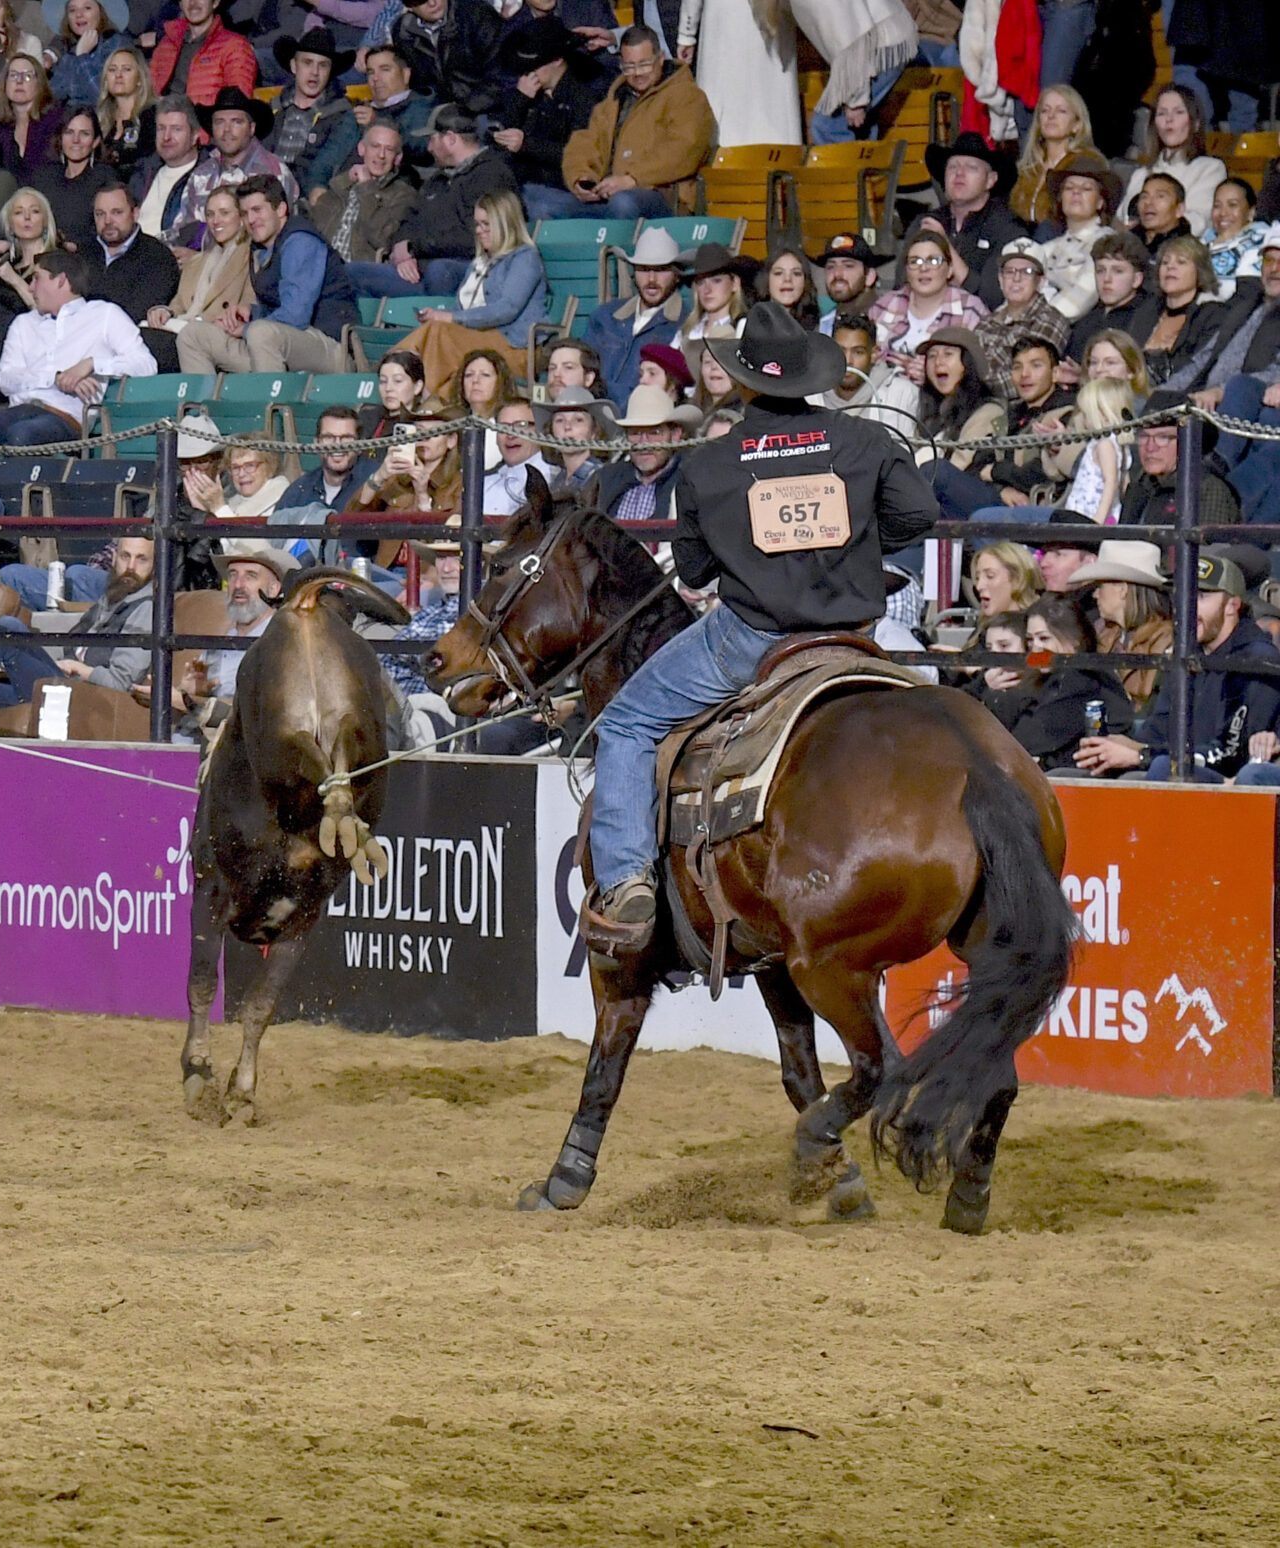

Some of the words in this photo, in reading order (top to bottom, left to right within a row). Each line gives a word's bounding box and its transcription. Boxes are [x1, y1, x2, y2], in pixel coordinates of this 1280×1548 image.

[596, 227, 607, 243] 9
[692, 225, 708, 241] 10
[177, 382, 188, 398] 8
[271, 380, 282, 397] 9
[357, 381, 374, 398] 10
[741, 431, 826, 451] RATTLER
[740, 450, 779, 462] NOTHING
[780, 446, 806, 457] COMES
[806, 443, 831, 454] CLOSE
[30, 465, 41, 481] 8
[125, 466, 136, 482] 9
[760, 492, 772, 501] 20
[824, 486, 835, 494] 26
[779, 502, 821, 524] 657
[327, 825, 505, 938] DLETON
[1062, 864, 1121, 945] cat
[344, 930, 453, 974] WHISKY
